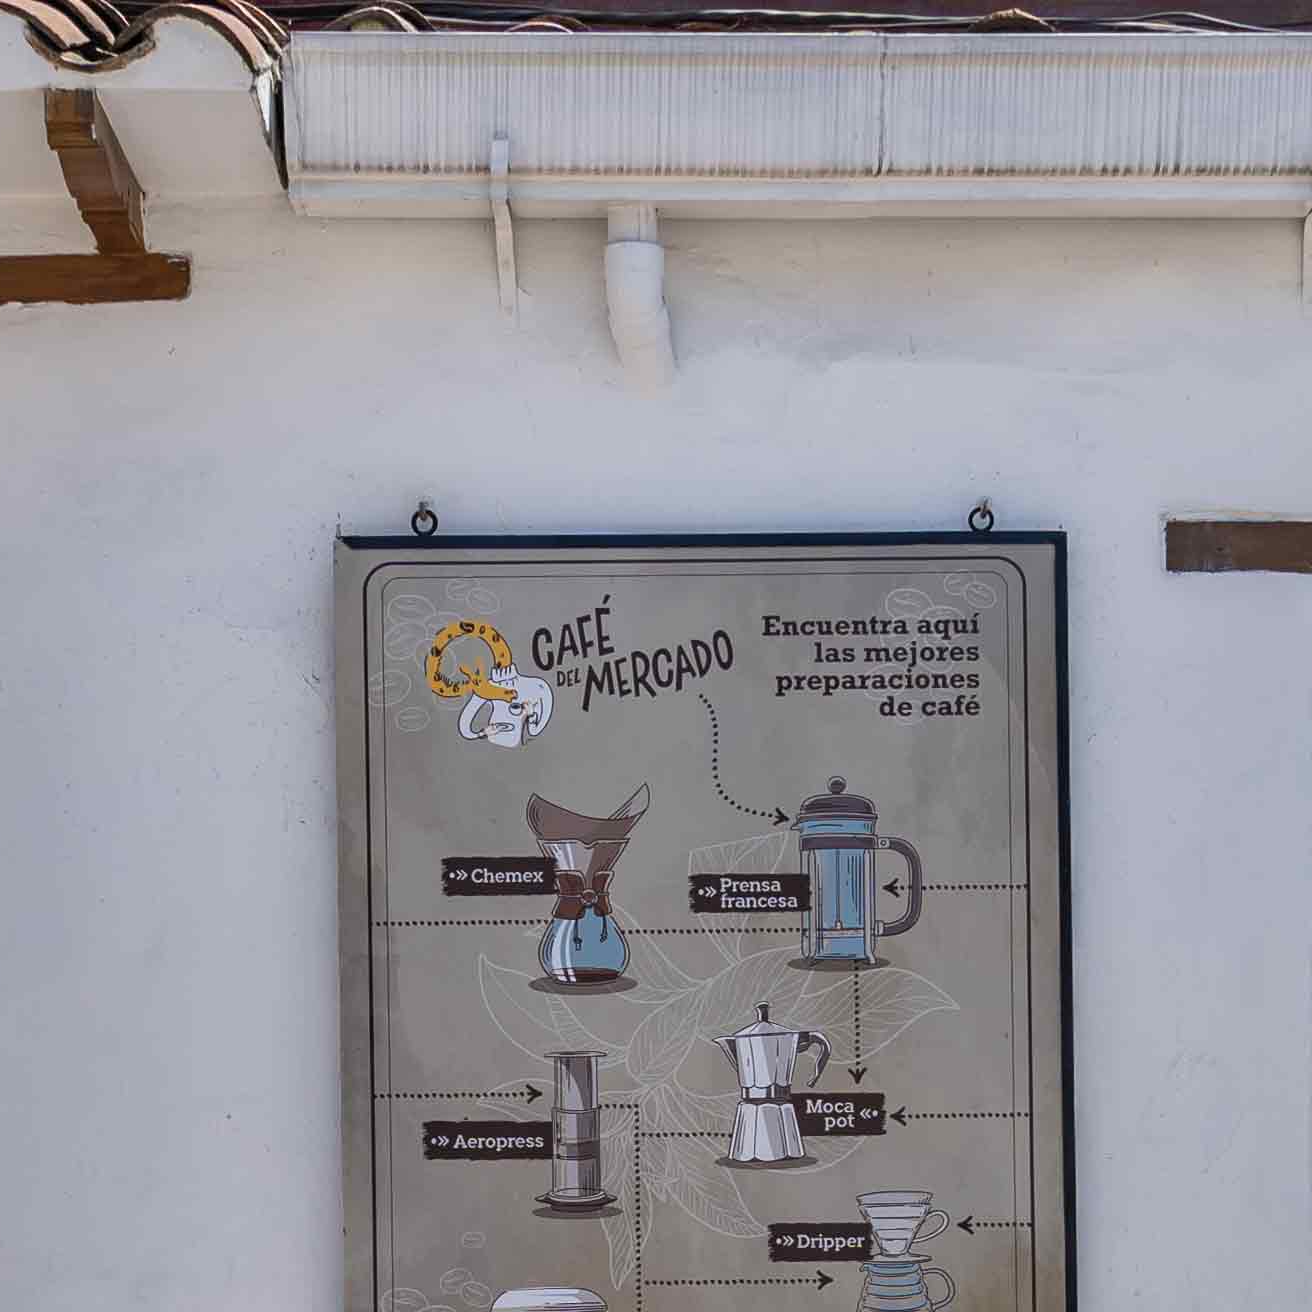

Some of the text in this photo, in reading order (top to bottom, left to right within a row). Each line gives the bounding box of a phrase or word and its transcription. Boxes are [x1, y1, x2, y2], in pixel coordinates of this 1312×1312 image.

[532, 594, 615, 671] CAFÉ
[762, 613, 980, 642] Encuentra aquí
[814, 642, 980, 668] las mejores
[556, 670, 582, 688] DEL
[581, 629, 734, 712] MERCADO
[775, 668, 980, 697] preparaciones
[879, 695, 981, 717] de café
[471, 868, 544, 884] Chemex
[720, 877, 781, 893] Prensa
[720, 894, 798, 909] francesa
[806, 1099, 854, 1114] Moca
[824, 1115, 854, 1131] pot
[453, 1133, 545, 1153] Aeropress
[797, 1233, 865, 1252] Dripper
